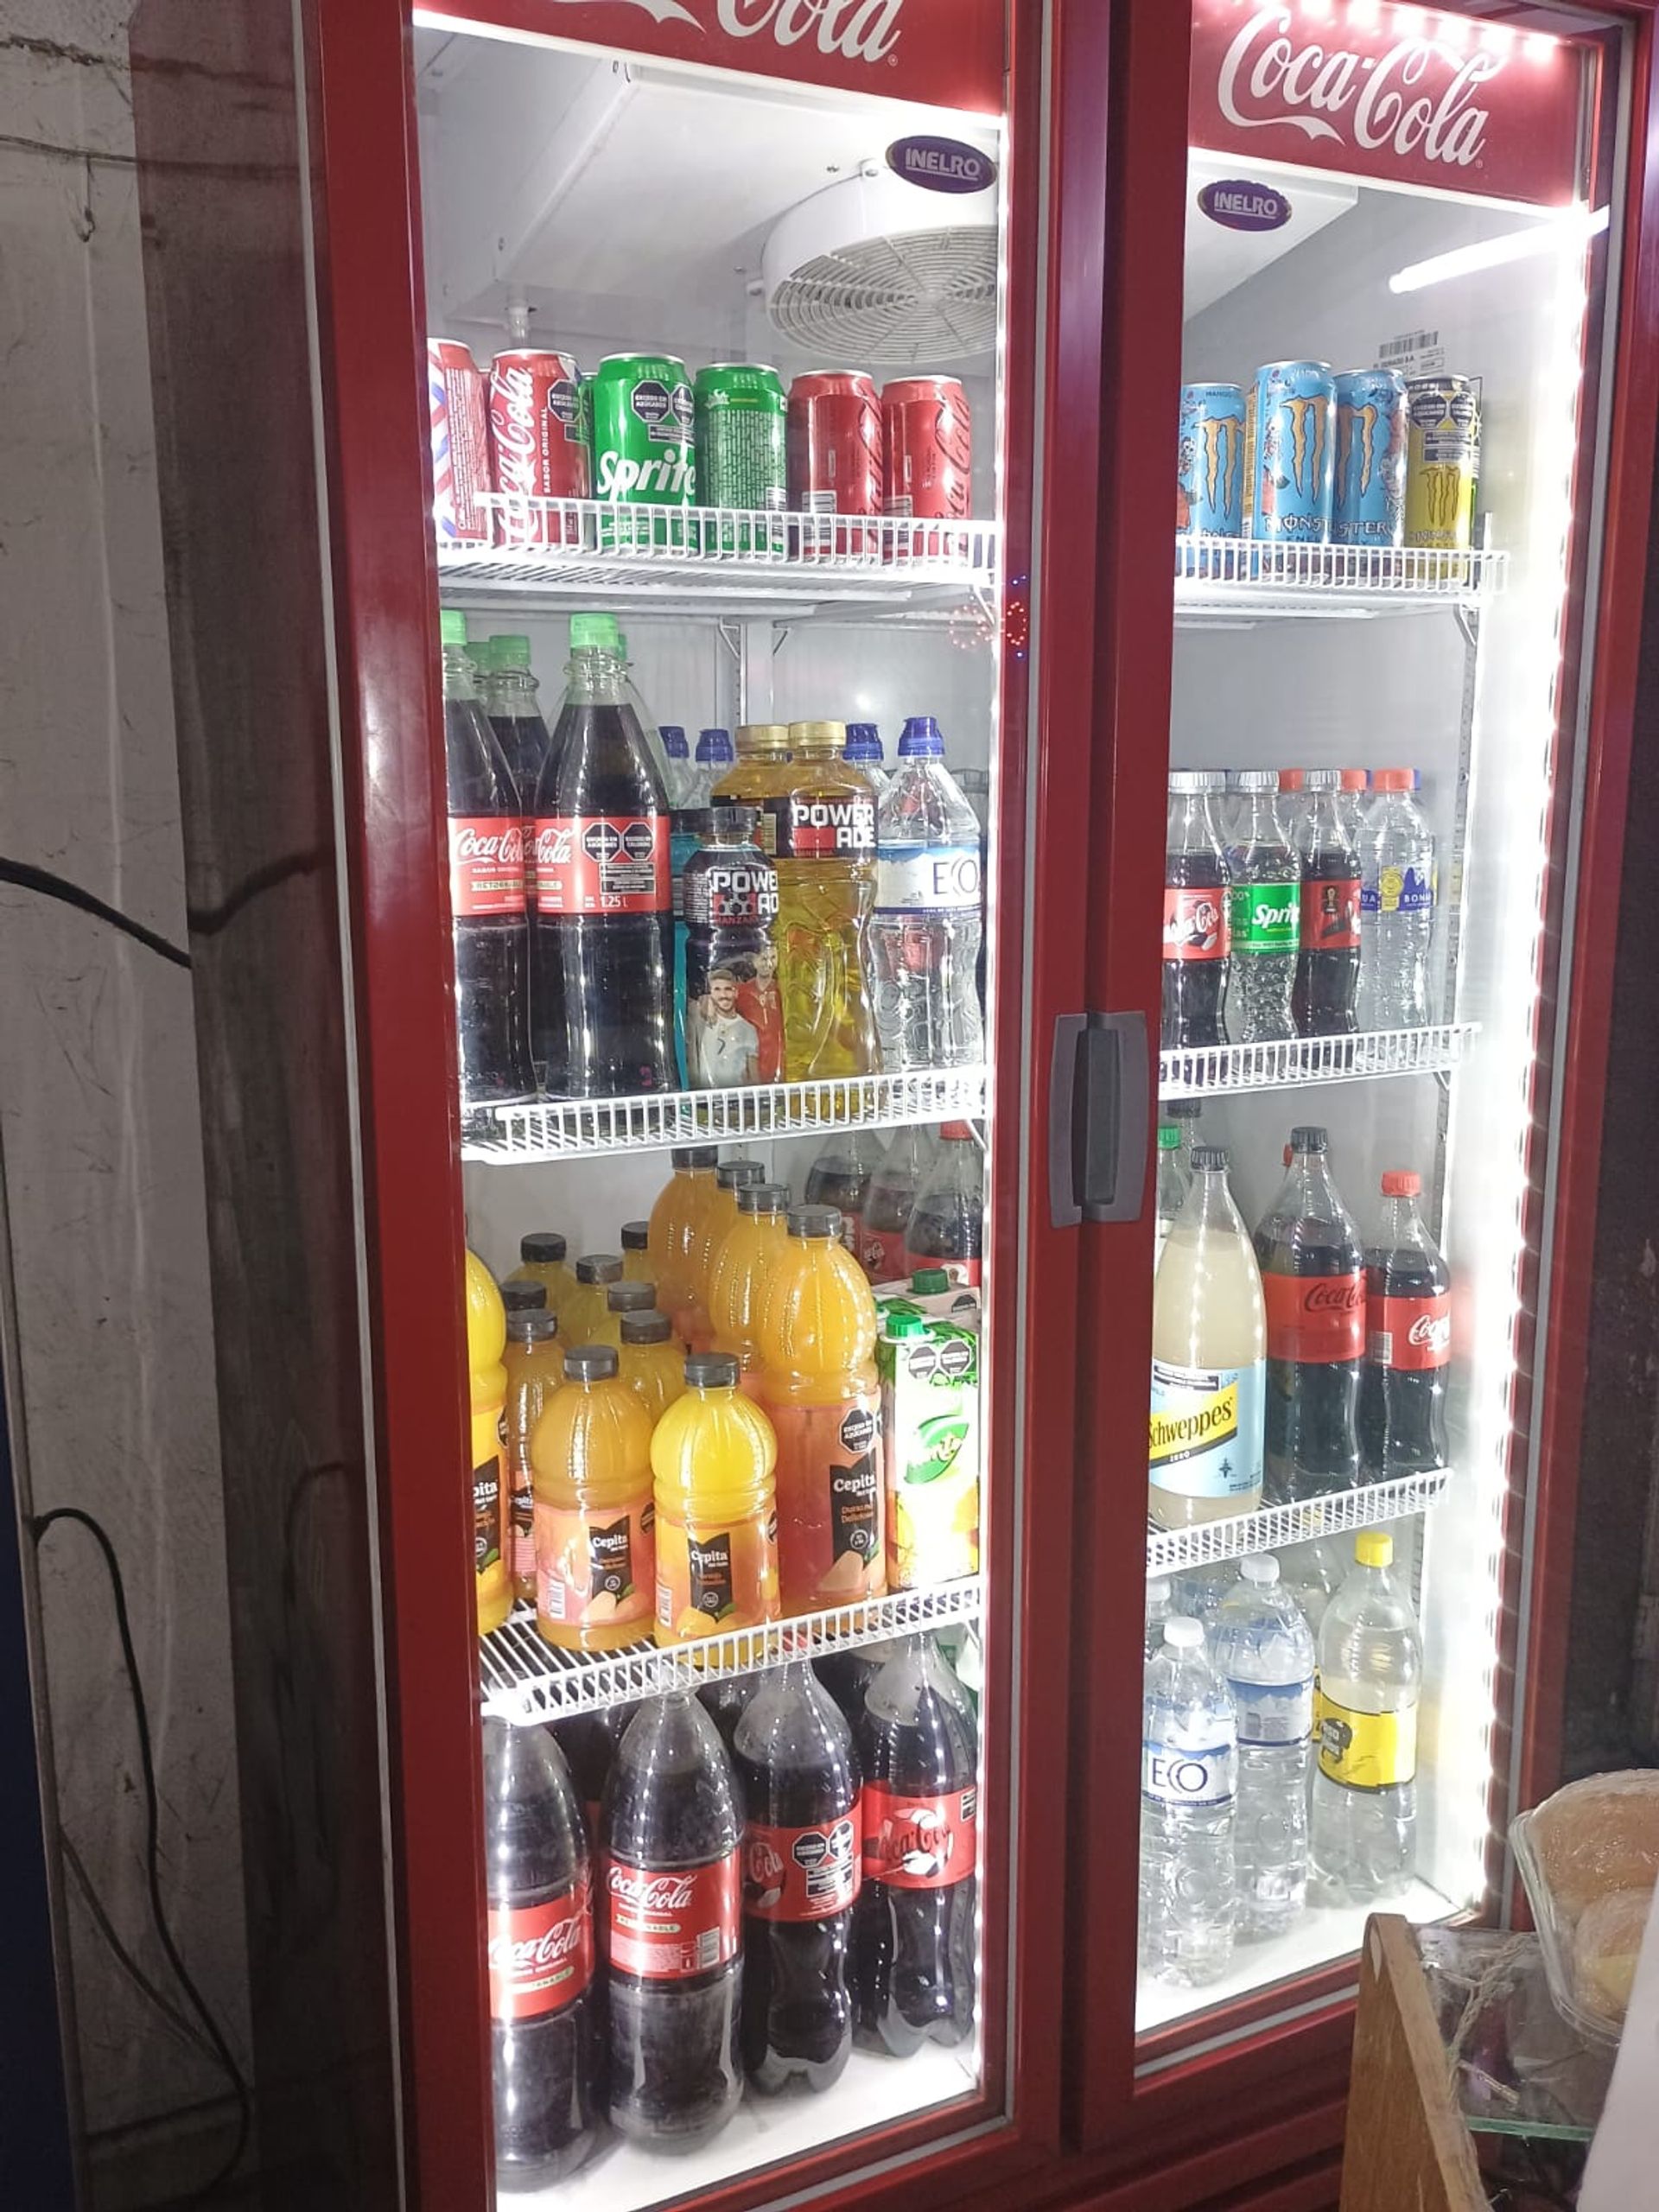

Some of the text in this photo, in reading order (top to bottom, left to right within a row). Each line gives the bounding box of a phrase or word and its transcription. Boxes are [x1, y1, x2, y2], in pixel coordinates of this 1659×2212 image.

[1217, 3, 1509, 167] Coca-Cola
[905, 147, 982, 178] INELRO
[1214, 189, 1278, 218] INELRO
[539, 407, 551, 493] SABOR ORIGINAL
[597, 448, 696, 503] Sprite
[792, 804, 874, 827] POWER
[836, 826, 876, 849] ADE
[712, 870, 779, 893] POWE
[757, 892, 779, 915] AD
[1251, 902, 1300, 929] Sprit
[473, 1481, 499, 1498] pita
[592, 1534, 628, 1550] Cepita
[1153, 1757, 1208, 1794] ECO
[608, 1866, 697, 1910] Coca-Cola
[489, 1911, 591, 1966] Cca-Cola
